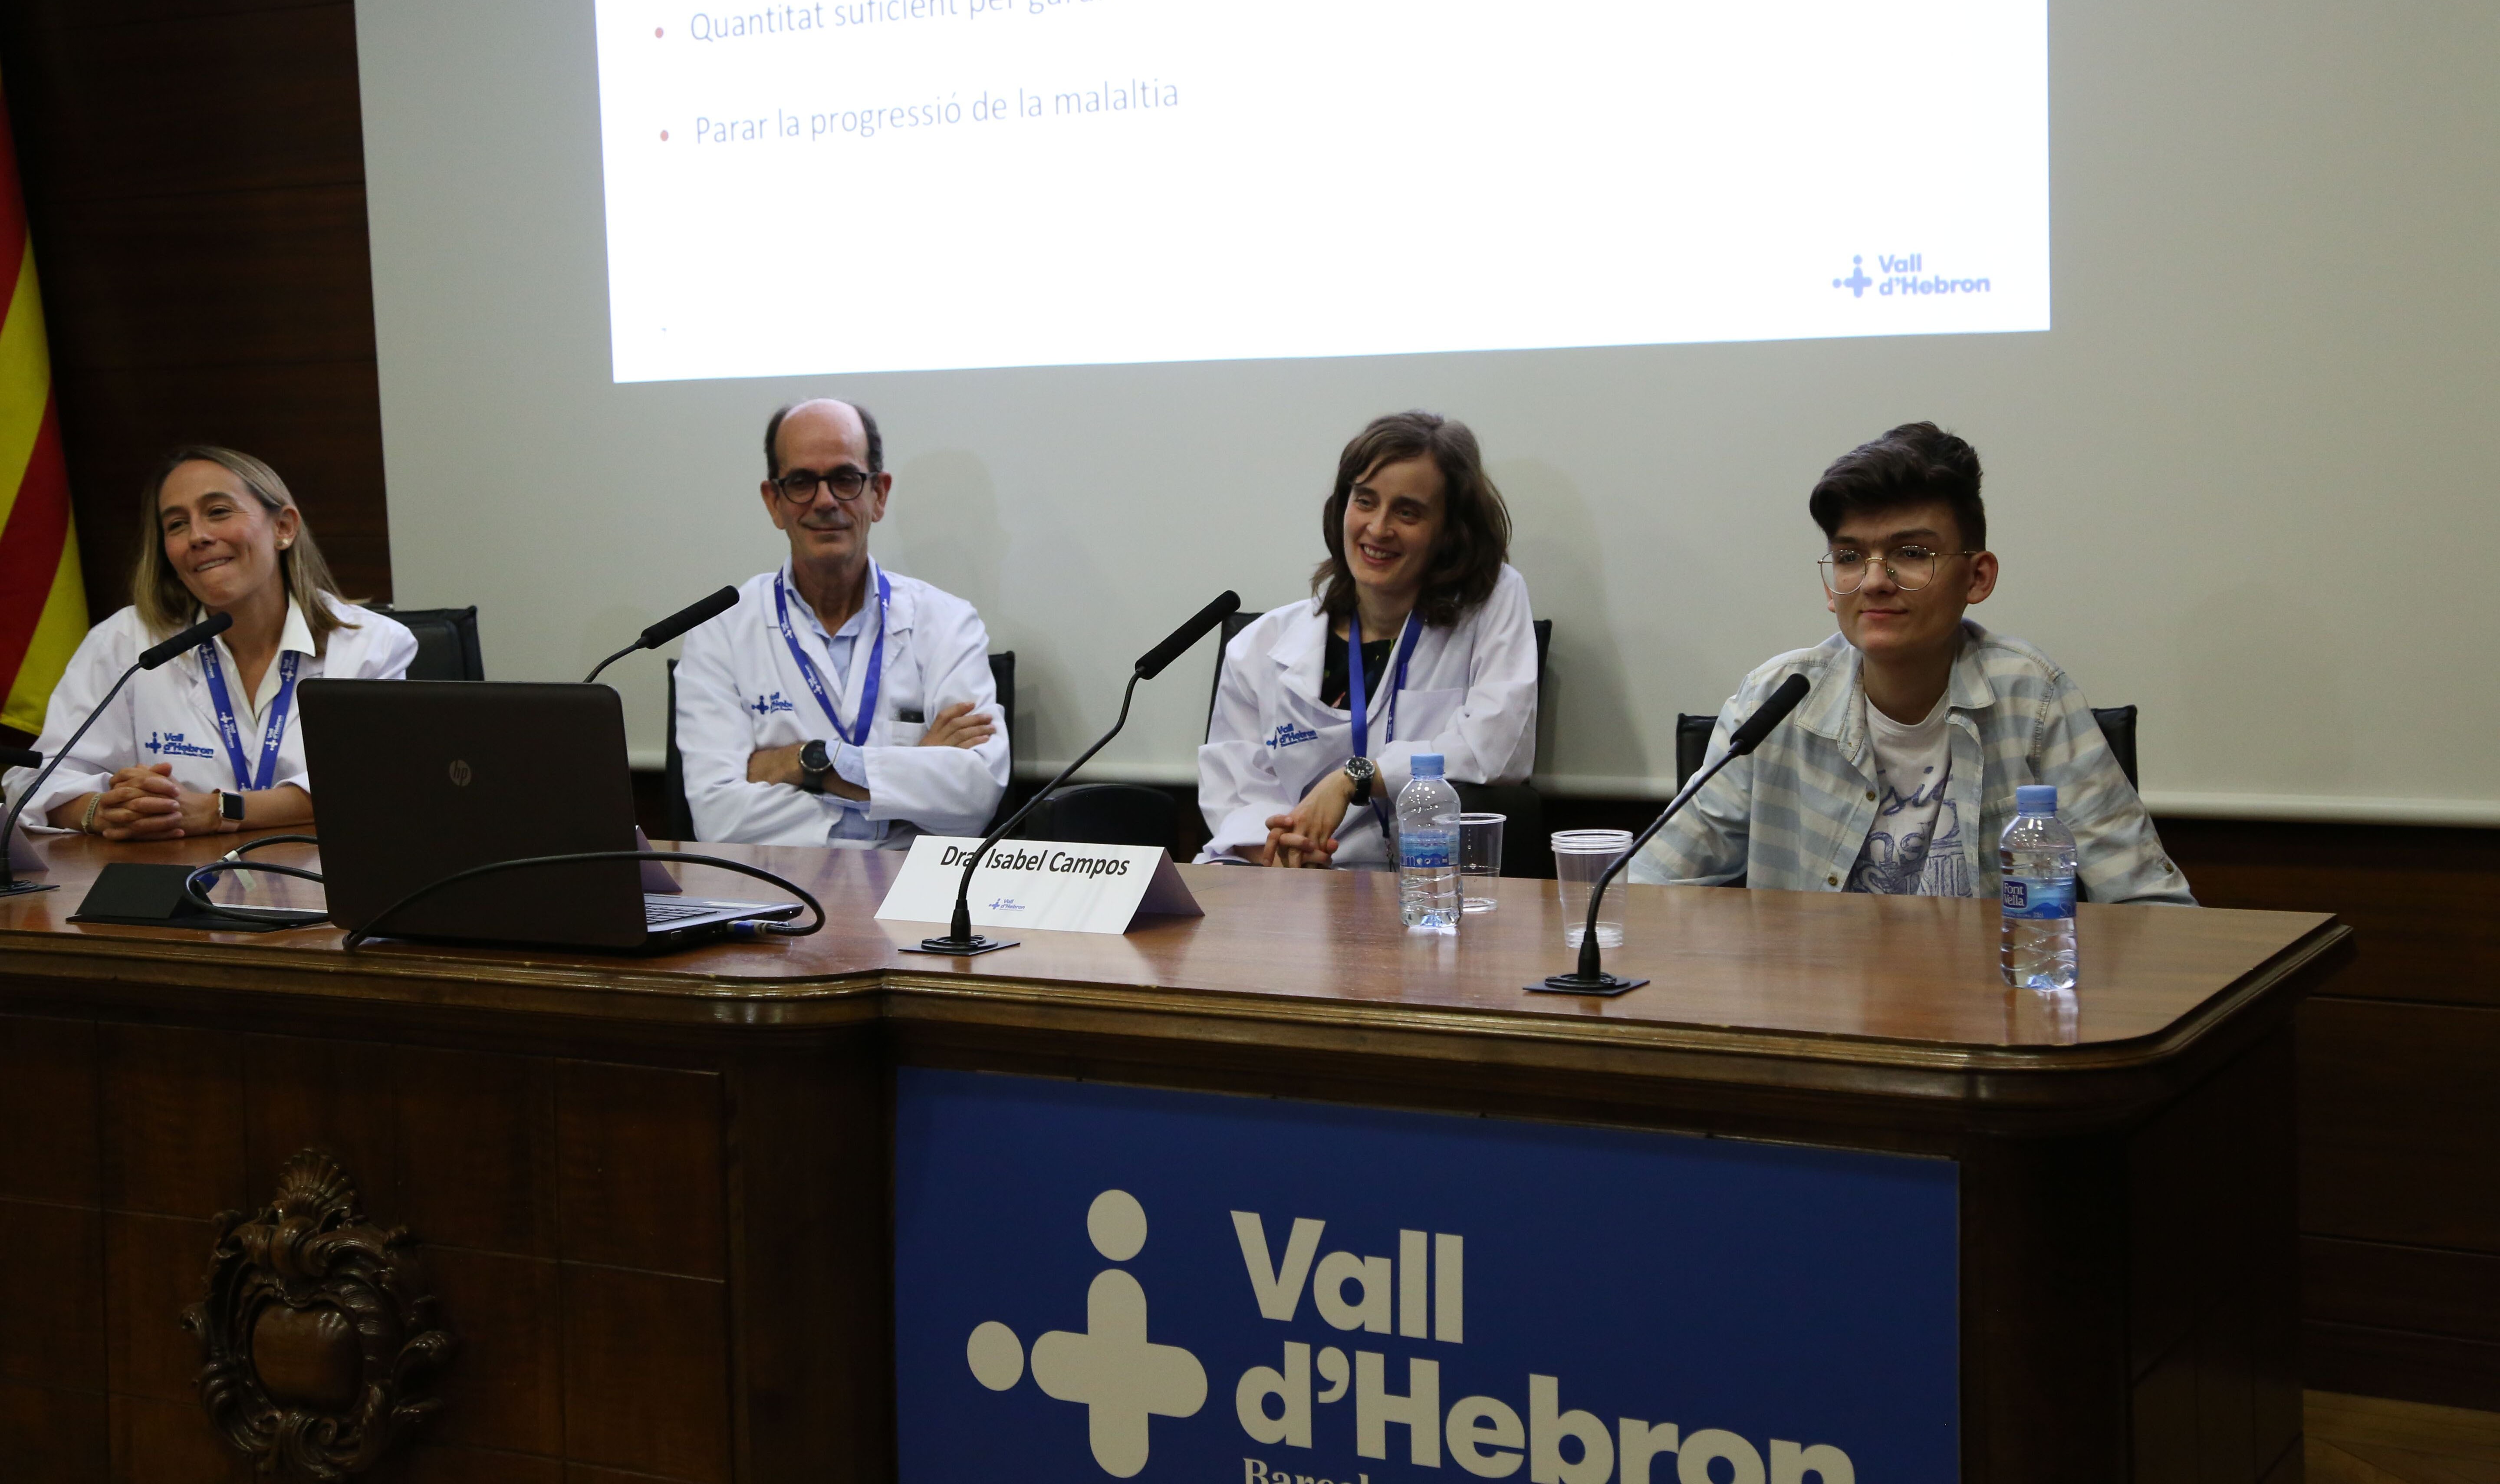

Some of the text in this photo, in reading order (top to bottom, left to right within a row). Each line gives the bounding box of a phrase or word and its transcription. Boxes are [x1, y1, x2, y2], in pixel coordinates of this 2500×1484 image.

[690, 1, 824, 43] Quantitat
[696, 78, 1178, 144] Parar la progressió de la malaltia
[1878, 253, 1922, 273] Vall
[1879, 275, 1991, 296] d’Hebron
[985, 848, 1048, 871] Isabel
[1049, 851, 1131, 879] Campos
[2004, 883, 2024, 895] Font
[2004, 894, 2025, 906] Vella
[1230, 1210, 1464, 1344] Vall
[1235, 1340, 1856, 1484] d’Hebron
